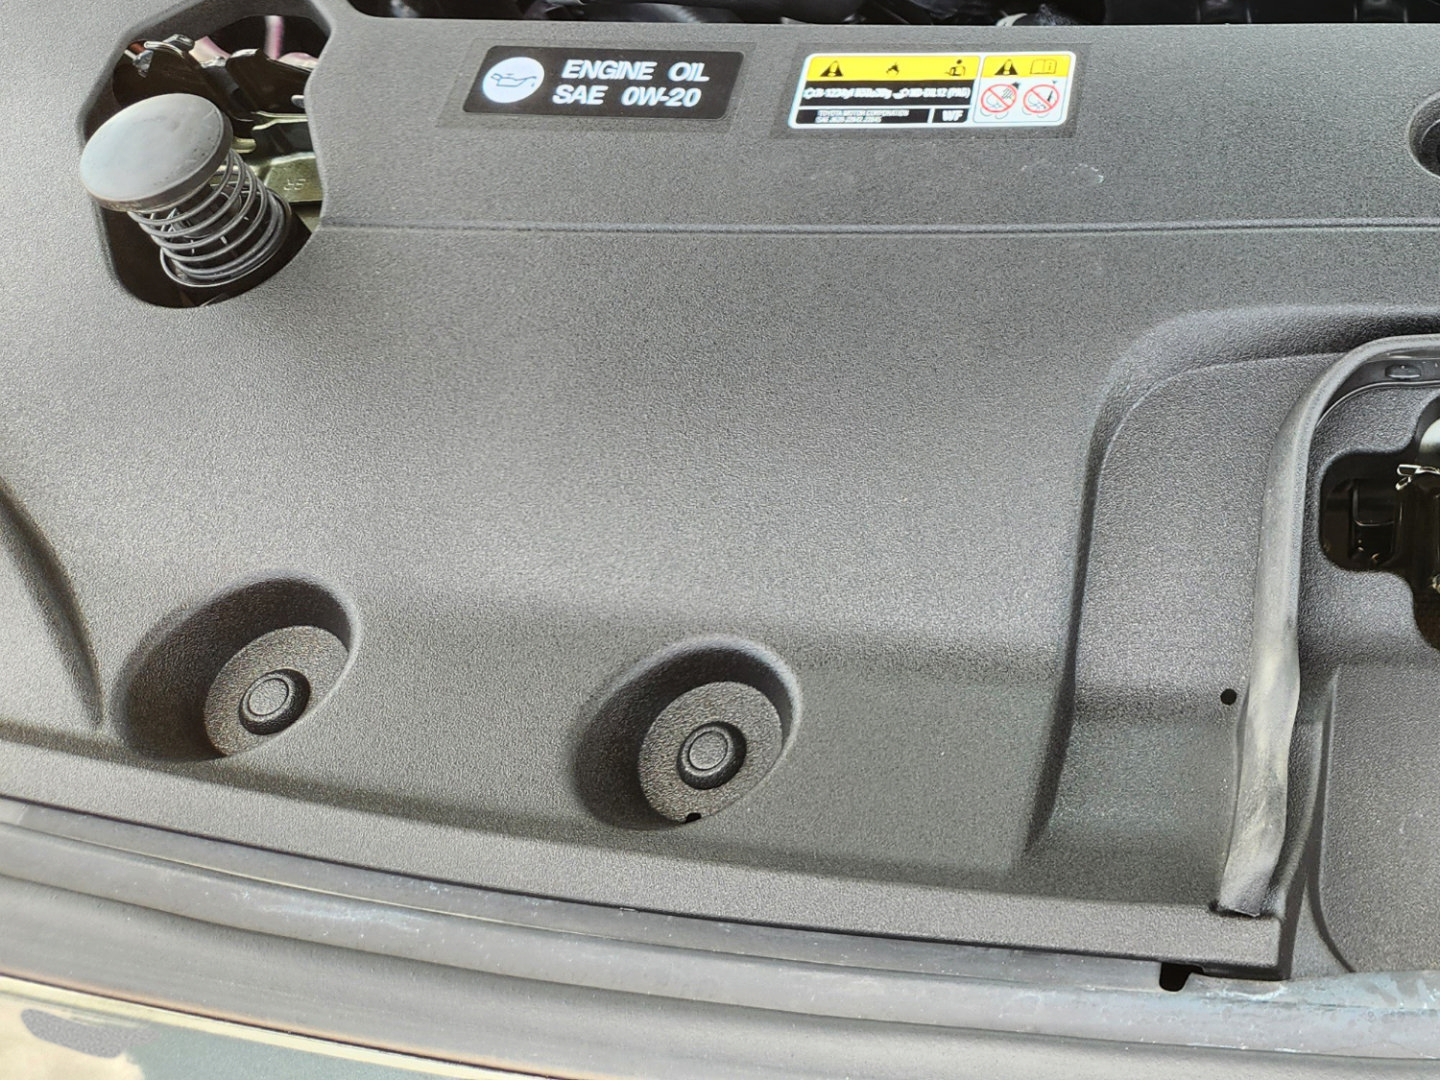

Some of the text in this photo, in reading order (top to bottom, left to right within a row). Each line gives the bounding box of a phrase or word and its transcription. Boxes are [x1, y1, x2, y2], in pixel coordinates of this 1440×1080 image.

[561, 59, 711, 82] ENGINE OIL
[552, 84, 702, 108] SAE 0W-20
